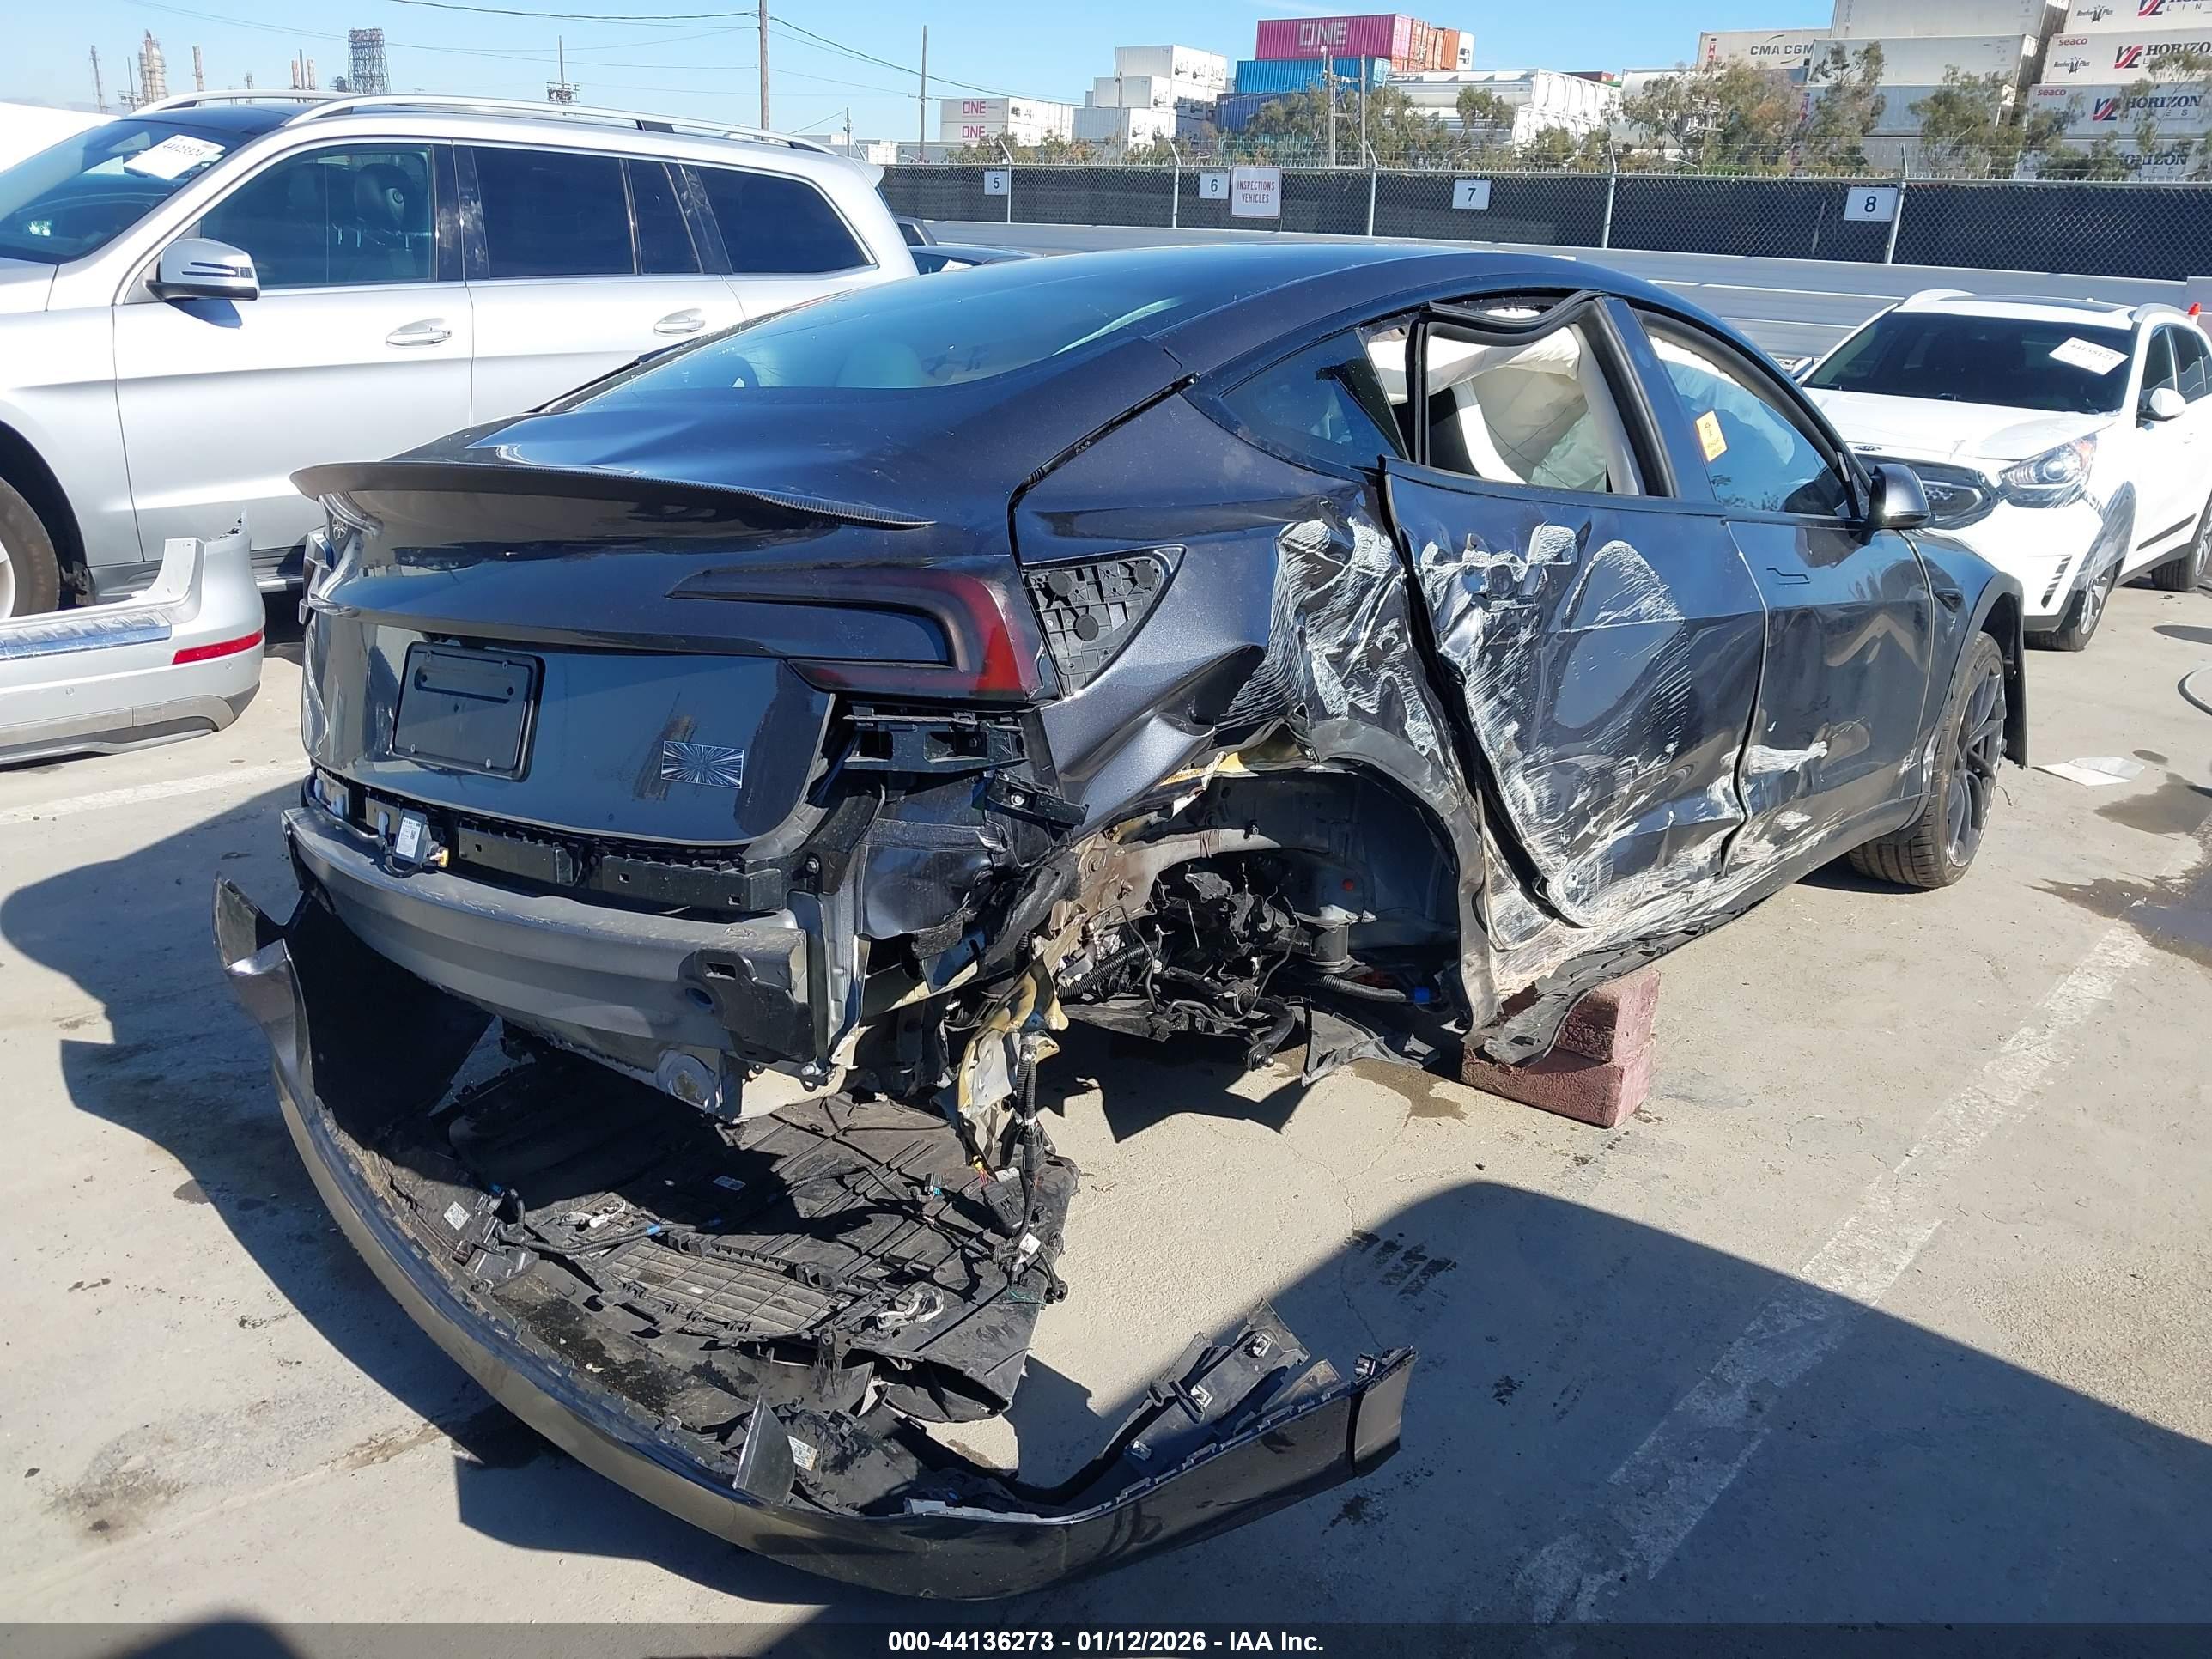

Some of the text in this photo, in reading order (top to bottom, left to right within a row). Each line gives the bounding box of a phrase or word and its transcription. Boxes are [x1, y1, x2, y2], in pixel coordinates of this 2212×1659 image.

[1299, 21, 1347, 46] ONE
[1750, 44, 1814, 55] CMA CGM
[2146, 41, 2212, 56] HORIZO
[962, 101, 987, 114] ONE
[2126, 95, 2203, 108] HORIZON
[962, 125, 986, 138] ONE
[993, 177, 1000, 189] 5
[1210, 179, 1218, 192] 6
[1237, 180, 1275, 191] INSPECTIONS
[1242, 194, 1269, 204] VEHICLES
[1468, 187, 1477, 202] 7
[1864, 196, 1877, 212] 8
